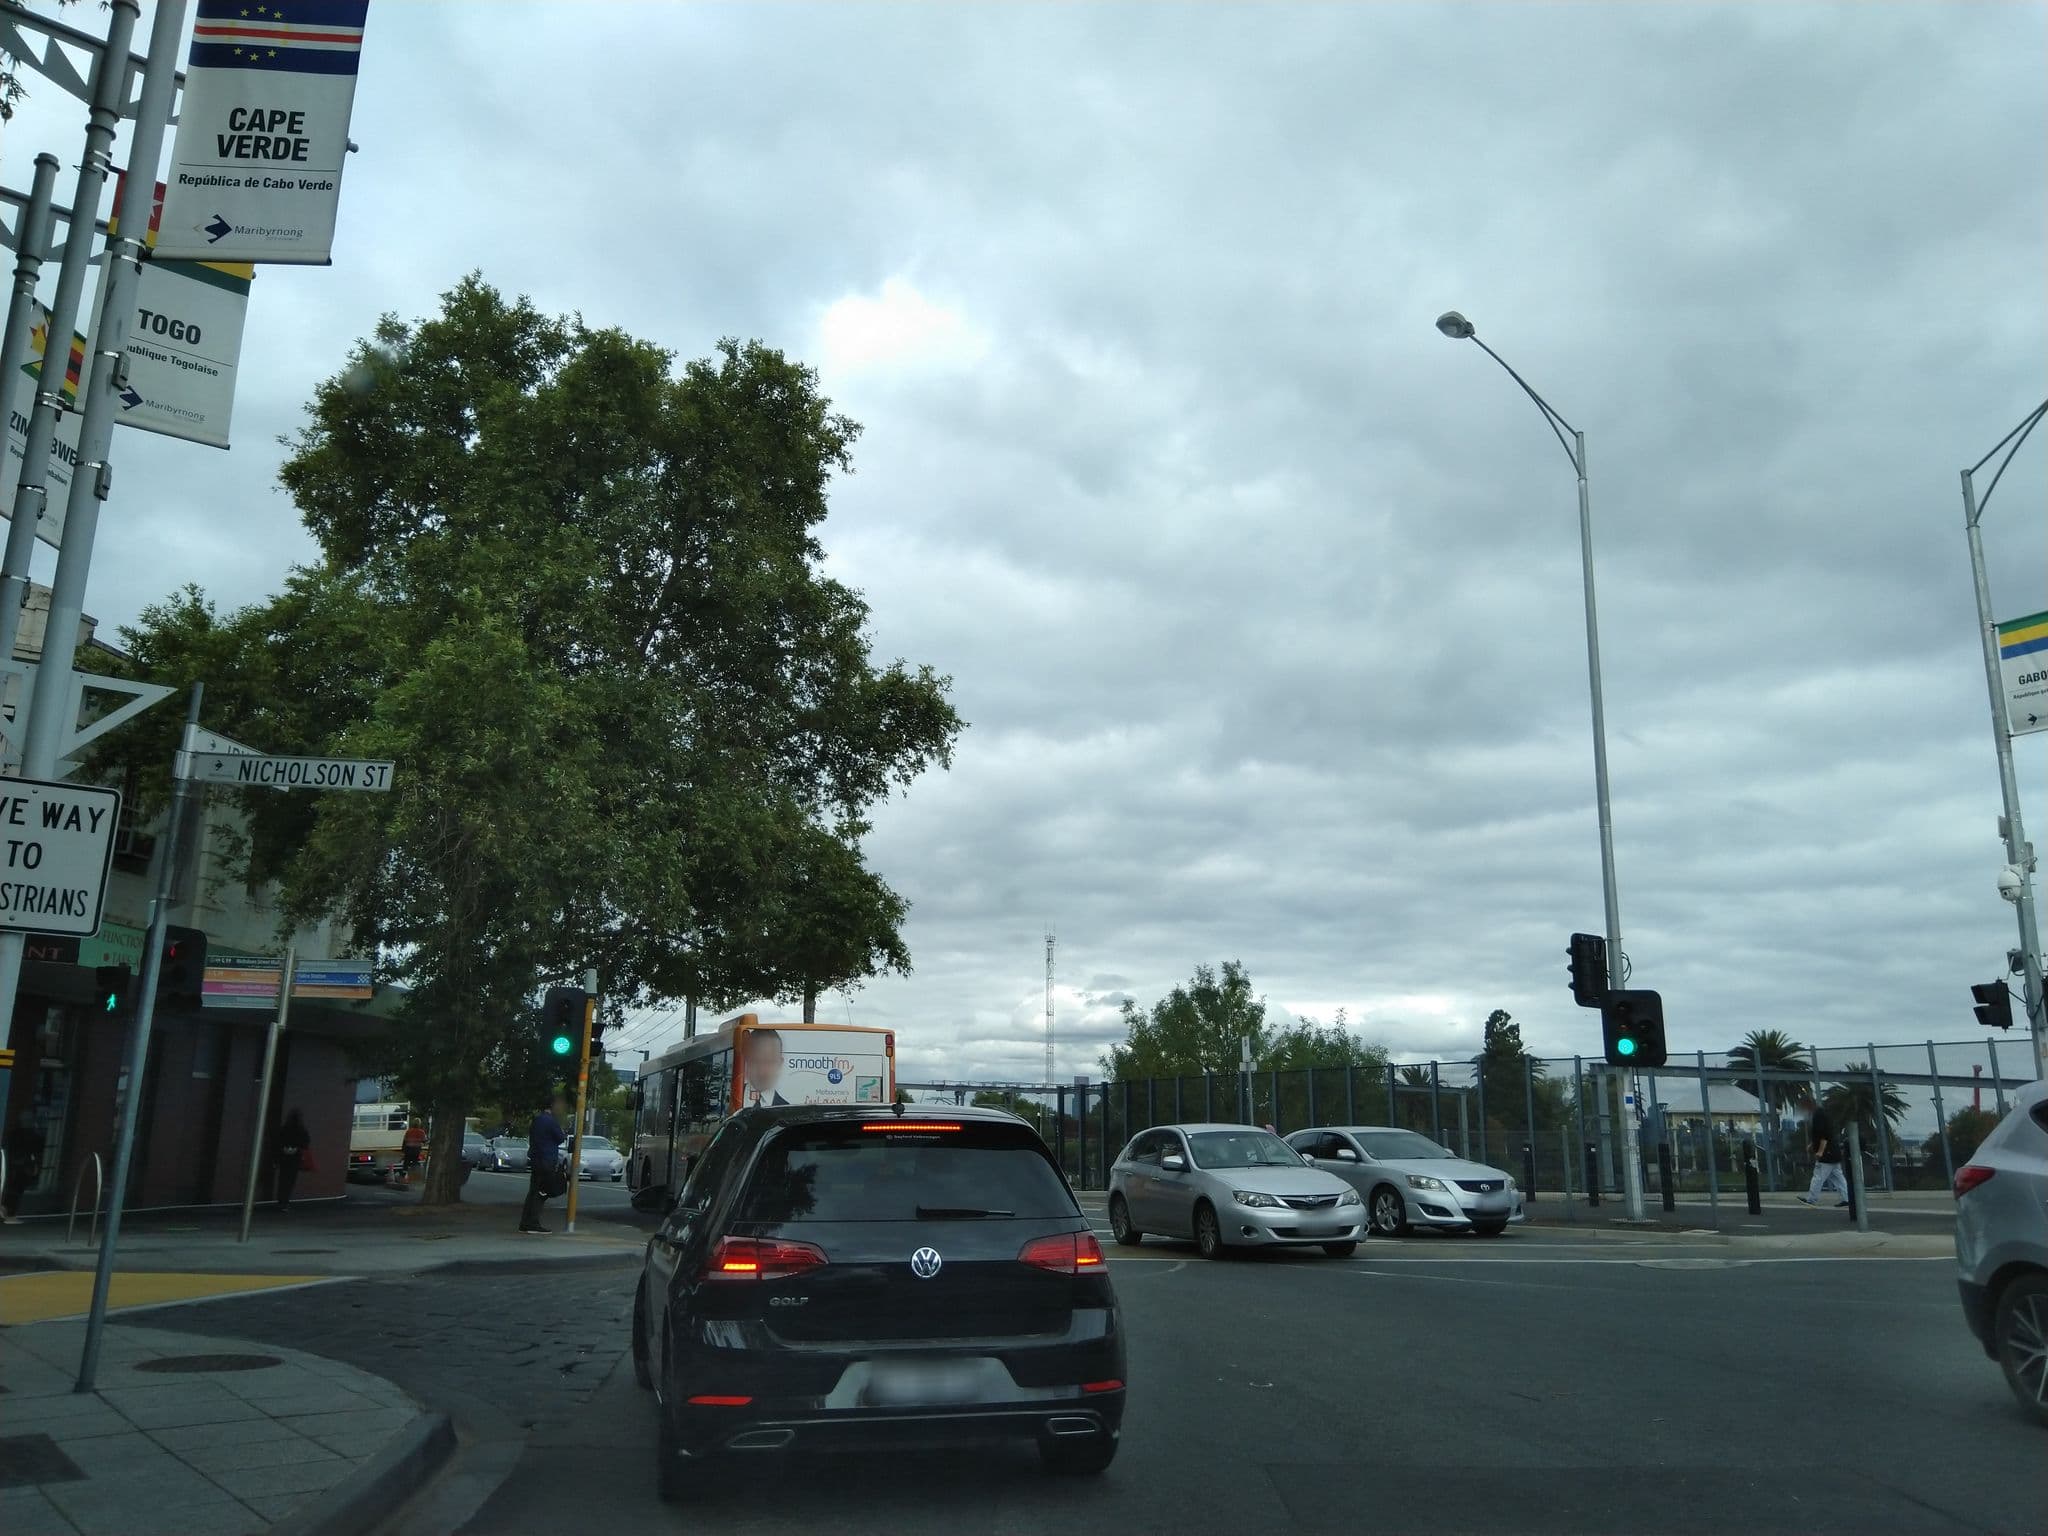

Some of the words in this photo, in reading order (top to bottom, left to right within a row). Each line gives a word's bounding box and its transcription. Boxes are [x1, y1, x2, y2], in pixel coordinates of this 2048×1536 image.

[229, 107, 305, 135] CAPE
[217, 135, 310, 162] VERDE
[179, 173, 241, 188] República
[245, 177, 260, 187] de
[263, 177, 294, 190] Cabo
[298, 179, 333, 191] Verde
[234, 225, 304, 238] Maribyrnong
[138, 308, 201, 345] TOGO
[170, 355, 219, 377] Togolaise
[146, 399, 206, 422] Maribyrnong
[2018, 669, 2048, 685] GABO
[238, 760, 356, 786] NICHOLSON
[362, 765, 389, 787] ST
[42, 801, 106, 833] WAY
[8, 840, 42, 869] TO
[789, 1056, 850, 1069] smoothfm
[769, 1297, 809, 1307] GOLF
